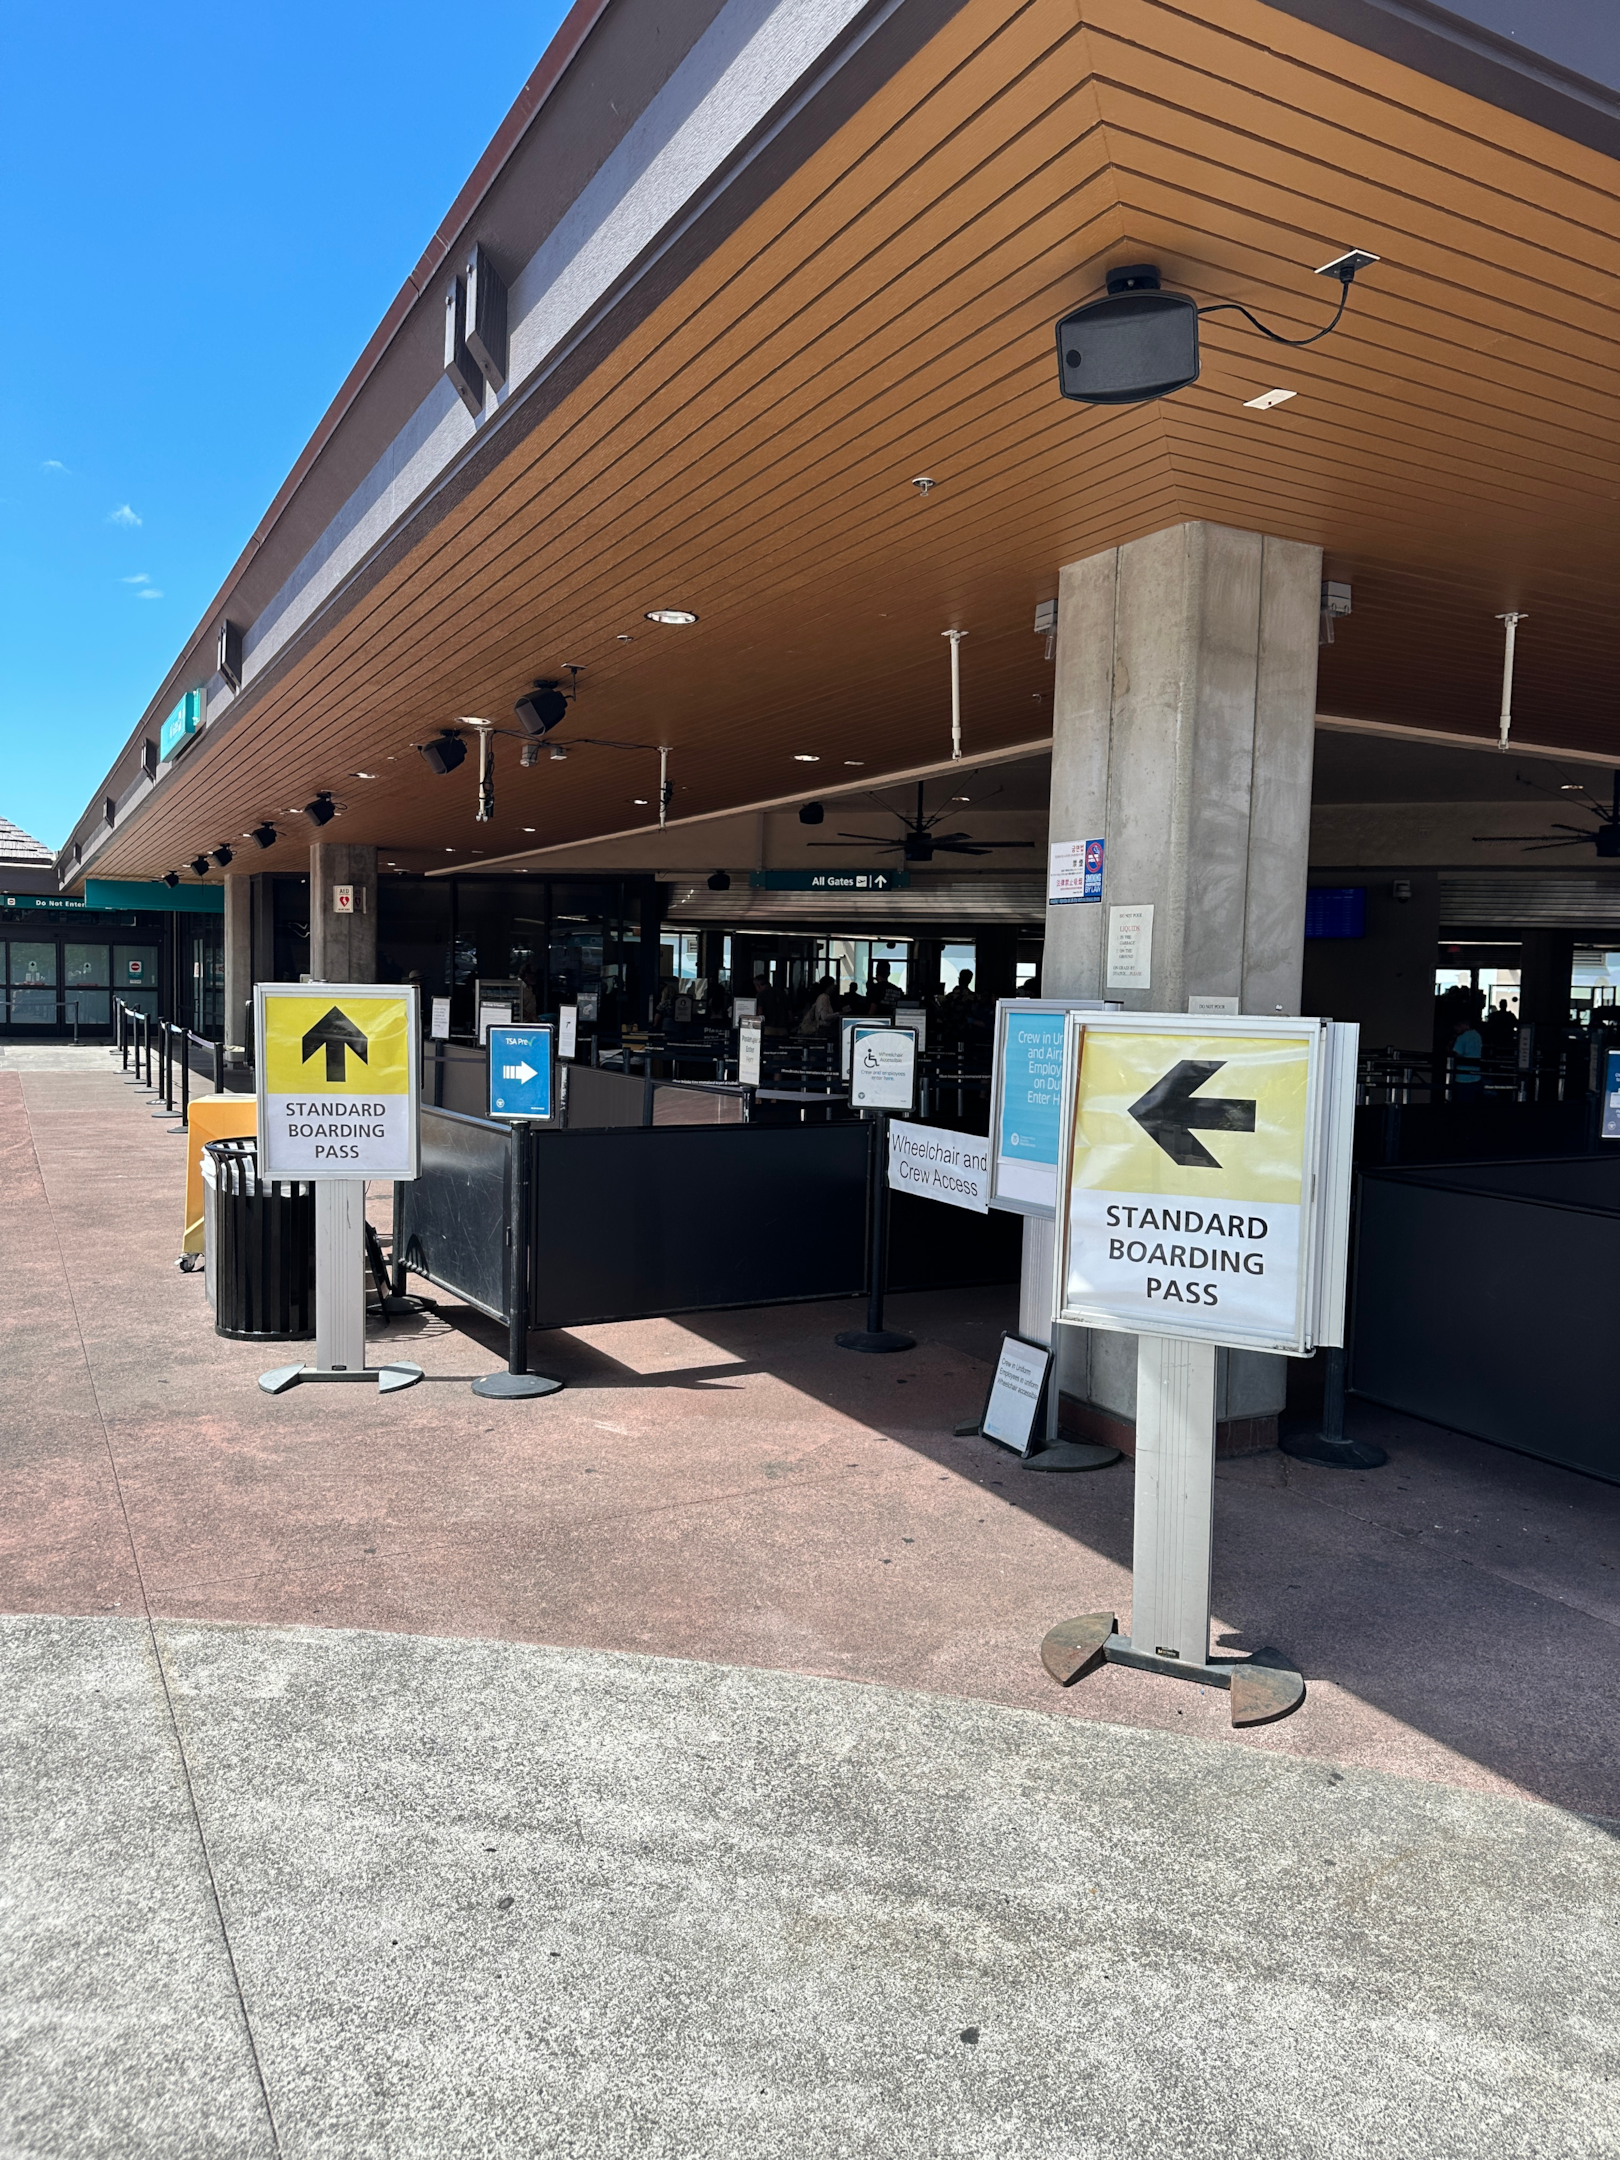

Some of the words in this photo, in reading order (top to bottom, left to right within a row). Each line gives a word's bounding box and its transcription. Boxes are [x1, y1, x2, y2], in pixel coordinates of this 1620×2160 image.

[812, 876, 825, 886] All
[827, 877, 854, 886] Gates
[1018, 1031, 1040, 1044] Crew
[1042, 1032, 1051, 1044] in
[1028, 1047, 1044, 1059] and
[1034, 1078, 1045, 1090] on
[1047, 1077, 1061, 1091] Du
[1027, 1091, 1050, 1105] Enter
[286, 1103, 386, 1117] STANDARD
[288, 1124, 385, 1138] BOARDING
[315, 1145, 359, 1159] PASS
[892, 1134, 960, 1166] Wheelchair
[963, 1153, 987, 1172] and
[900, 1160, 930, 1184] Crew
[933, 1169, 978, 1197] Access
[1106, 1205, 1268, 1240] STANDARD
[1109, 1238, 1264, 1276] BOARDING
[1147, 1277, 1218, 1306] PASS
[1002, 1358, 1012, 1368] Crew
[1016, 1363, 1031, 1376] Uniform
[999, 1367, 1020, 1382] Employees
[997, 1377, 1018, 1391] Wheelchair
